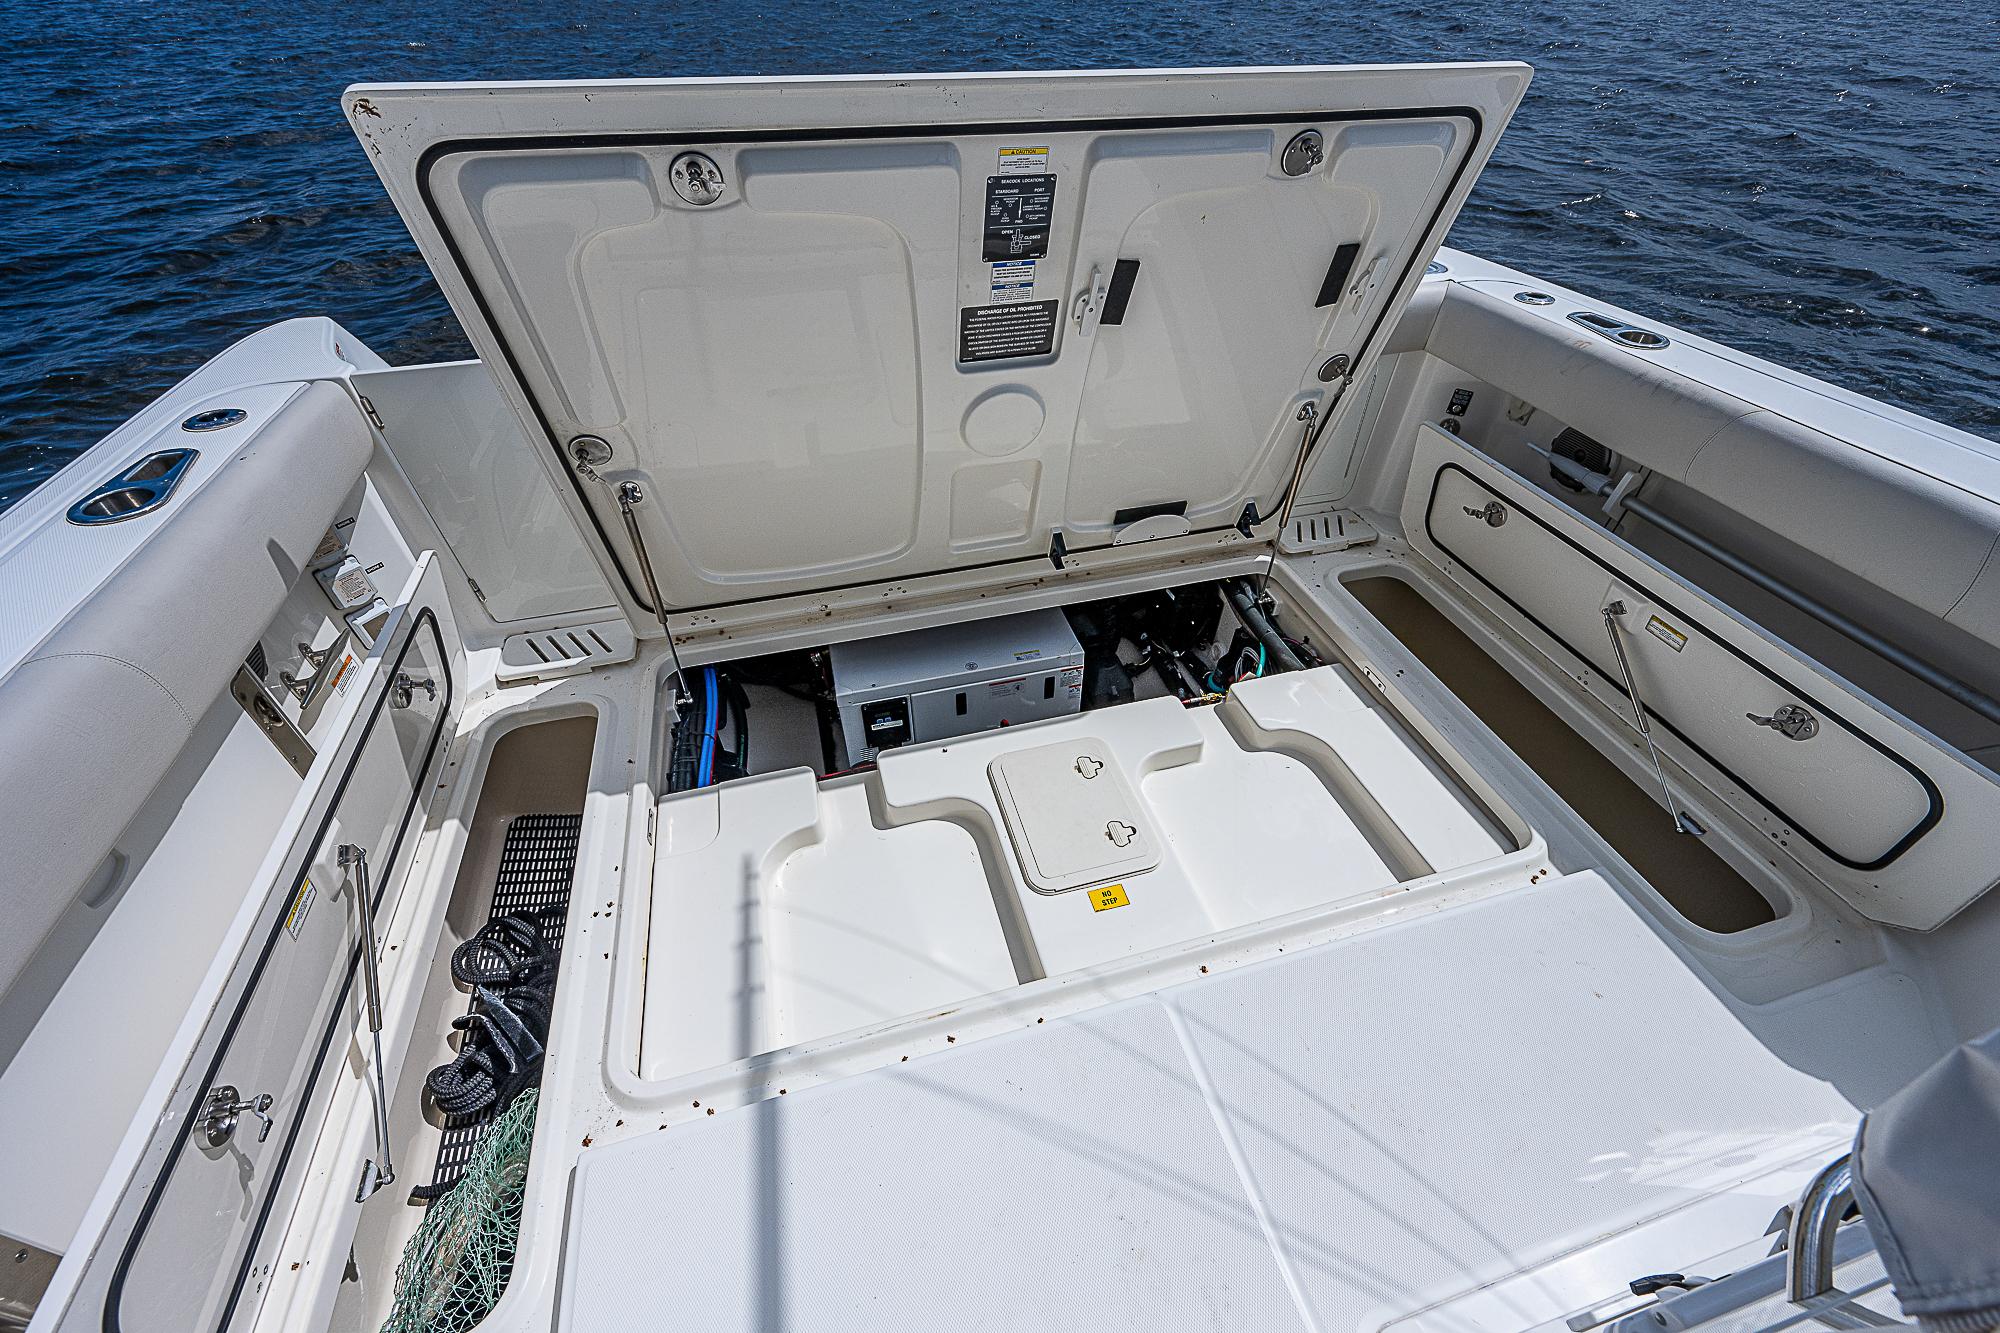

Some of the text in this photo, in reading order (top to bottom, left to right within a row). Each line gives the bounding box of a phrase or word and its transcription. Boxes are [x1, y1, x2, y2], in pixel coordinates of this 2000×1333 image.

[1017, 304, 1043, 312] PROHIBITED
[1101, 889, 1112, 897] NO
[1101, 896, 1118, 906] STEP
